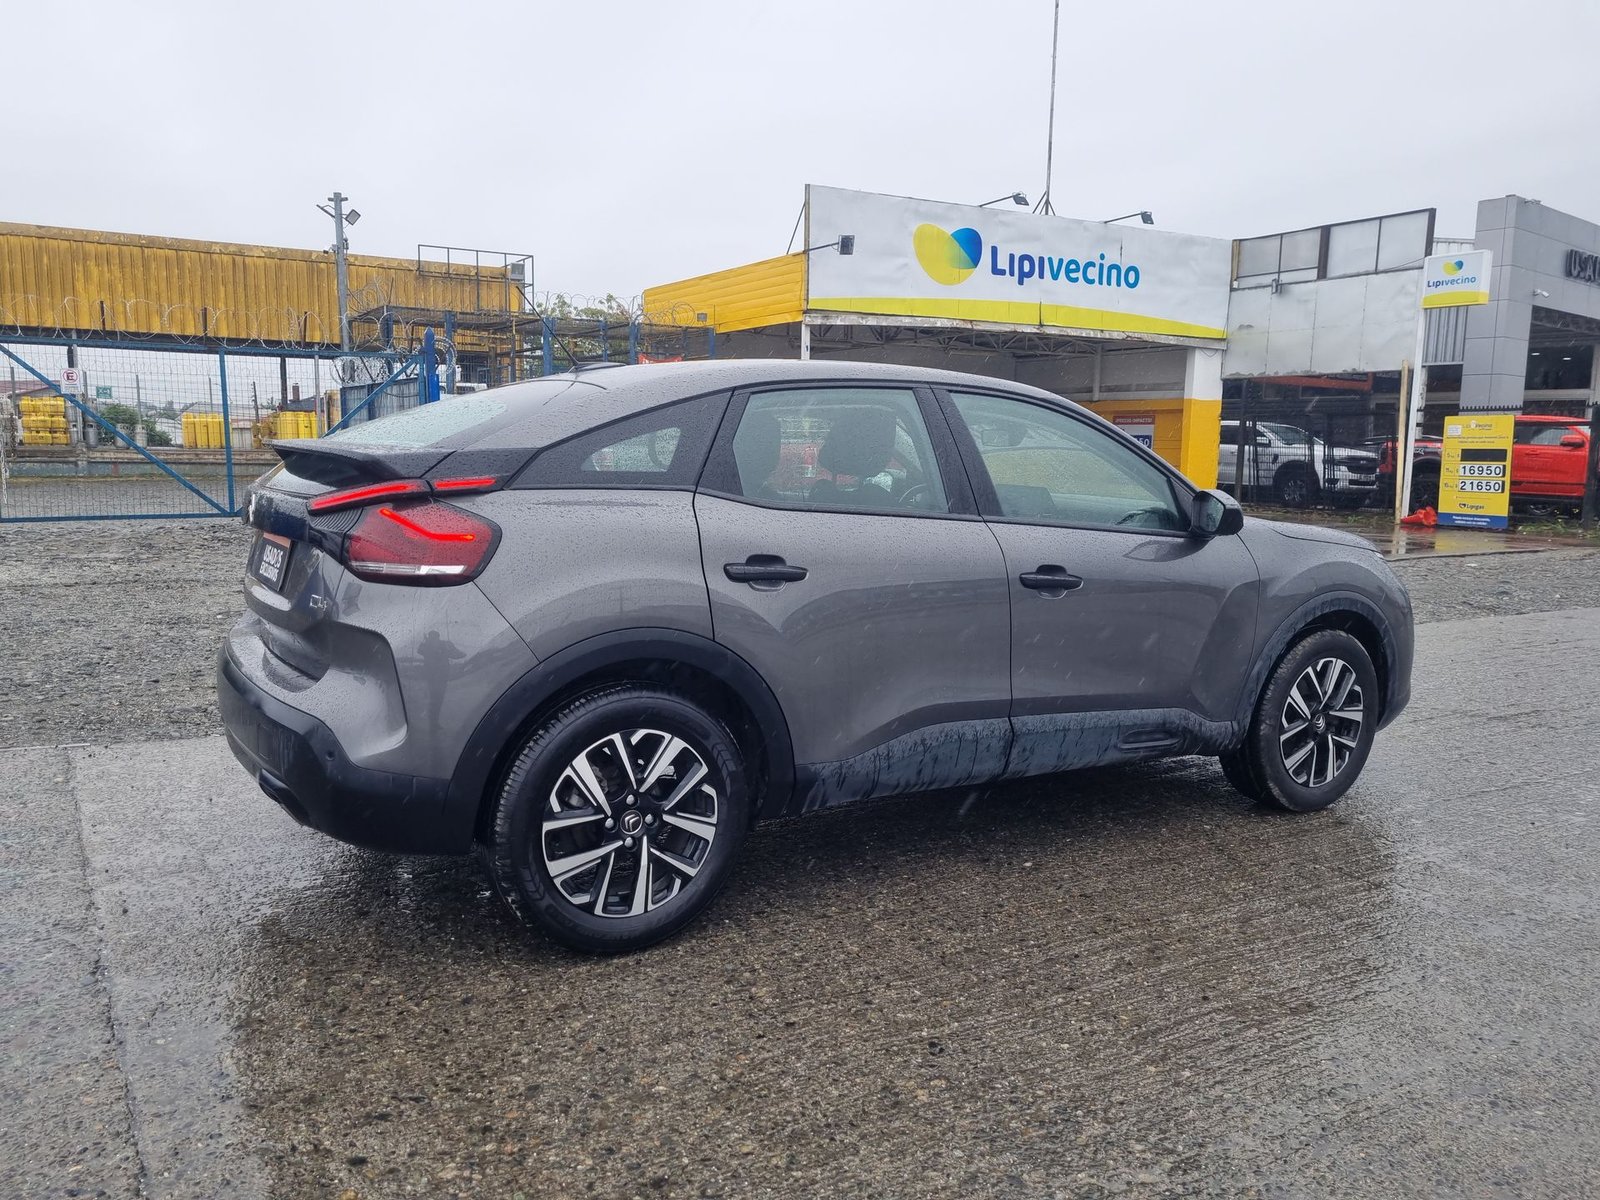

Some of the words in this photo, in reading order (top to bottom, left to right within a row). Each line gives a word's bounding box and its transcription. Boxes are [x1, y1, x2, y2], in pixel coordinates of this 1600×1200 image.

[990, 245, 1140, 289] Lipivecino
[1566, 249, 1600, 281] USA
[1427, 275, 1477, 288] Lipivecino
[1461, 465, 1502, 476] 16950
[1460, 480, 1501, 492] 21650
[263, 544, 283, 568] USADOS
